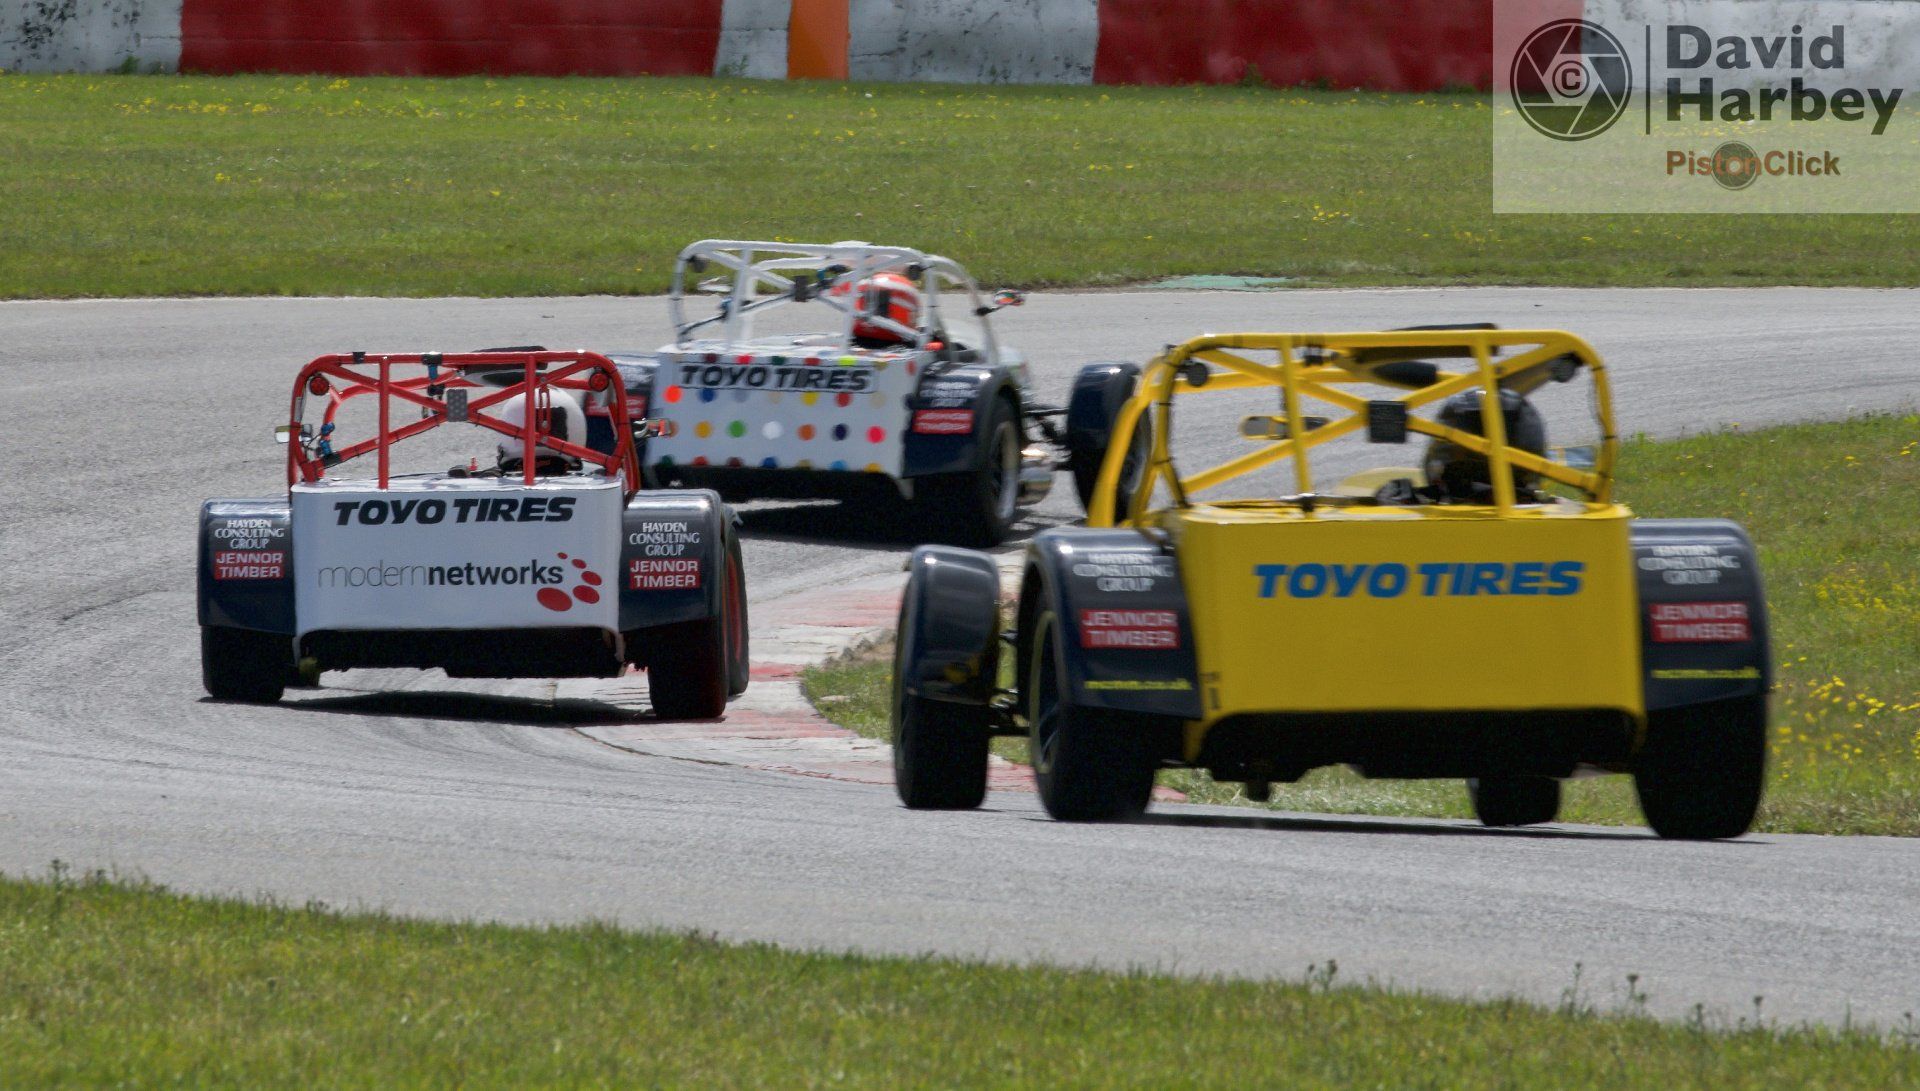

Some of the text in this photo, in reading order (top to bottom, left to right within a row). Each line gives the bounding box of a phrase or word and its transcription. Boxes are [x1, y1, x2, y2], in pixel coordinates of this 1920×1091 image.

[681, 364, 771, 388] TOYO
[774, 367, 872, 391] TIRES
[334, 496, 577, 526] TOYO TIRES
[226, 519, 272, 528] HAYDEN
[642, 521, 687, 533] HAYDEN
[214, 528, 285, 539] CONSULTING
[629, 532, 701, 545] CONSULTING
[229, 538, 270, 550] GROUP
[644, 544, 685, 556] GROUP
[216, 553, 283, 564] JENNOR
[219, 566, 281, 578] TIMBER
[630, 560, 698, 573] JENNOR
[317, 559, 564, 588] modernnetworks
[633, 574, 697, 588] TIMBER
[1254, 561, 1586, 599] TOYO TIRES
